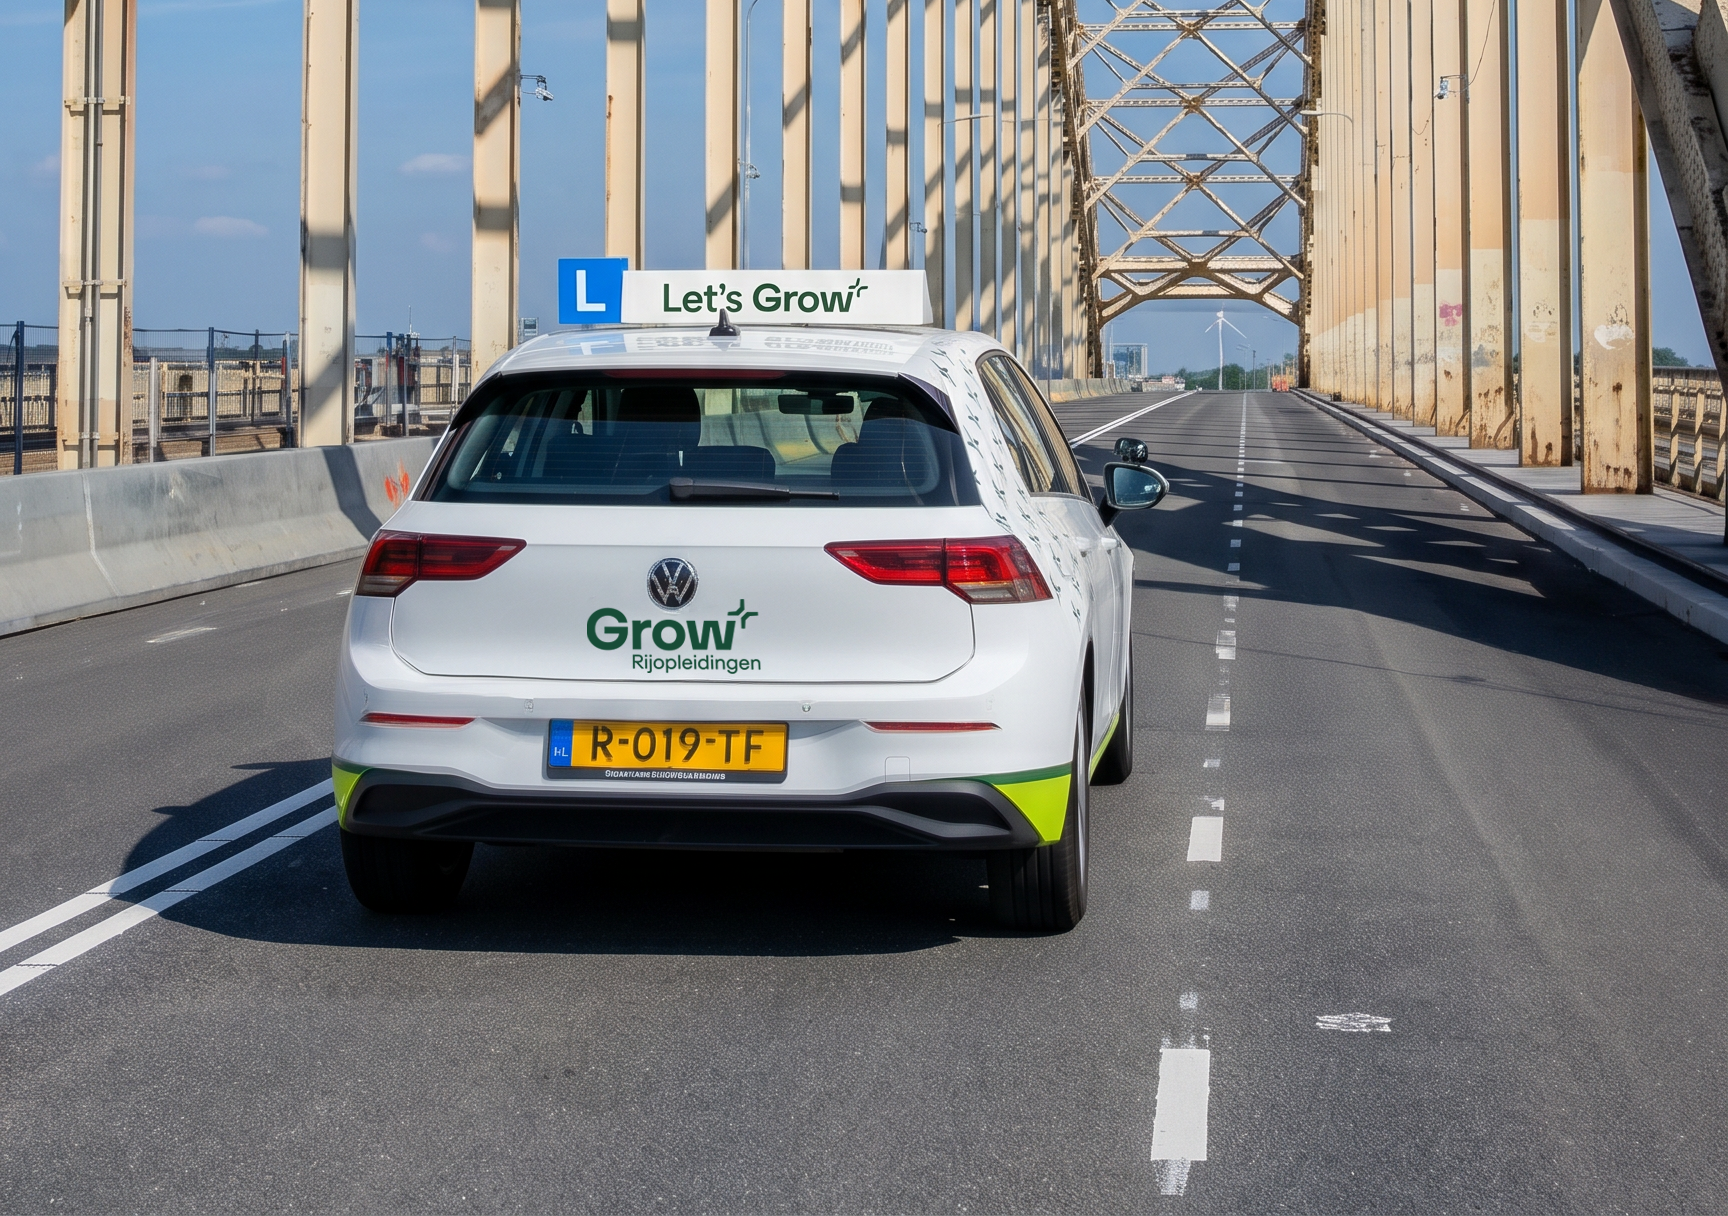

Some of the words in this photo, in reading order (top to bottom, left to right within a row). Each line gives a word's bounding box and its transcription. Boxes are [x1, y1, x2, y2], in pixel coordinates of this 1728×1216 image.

[576, 269, 606, 312] L
[663, 282, 743, 313] Let's
[752, 282, 854, 313] Grow
[586, 607, 737, 652] Grow
[632, 654, 762, 674] Rijopleidingen
[590, 725, 765, 765] R-019-TF
